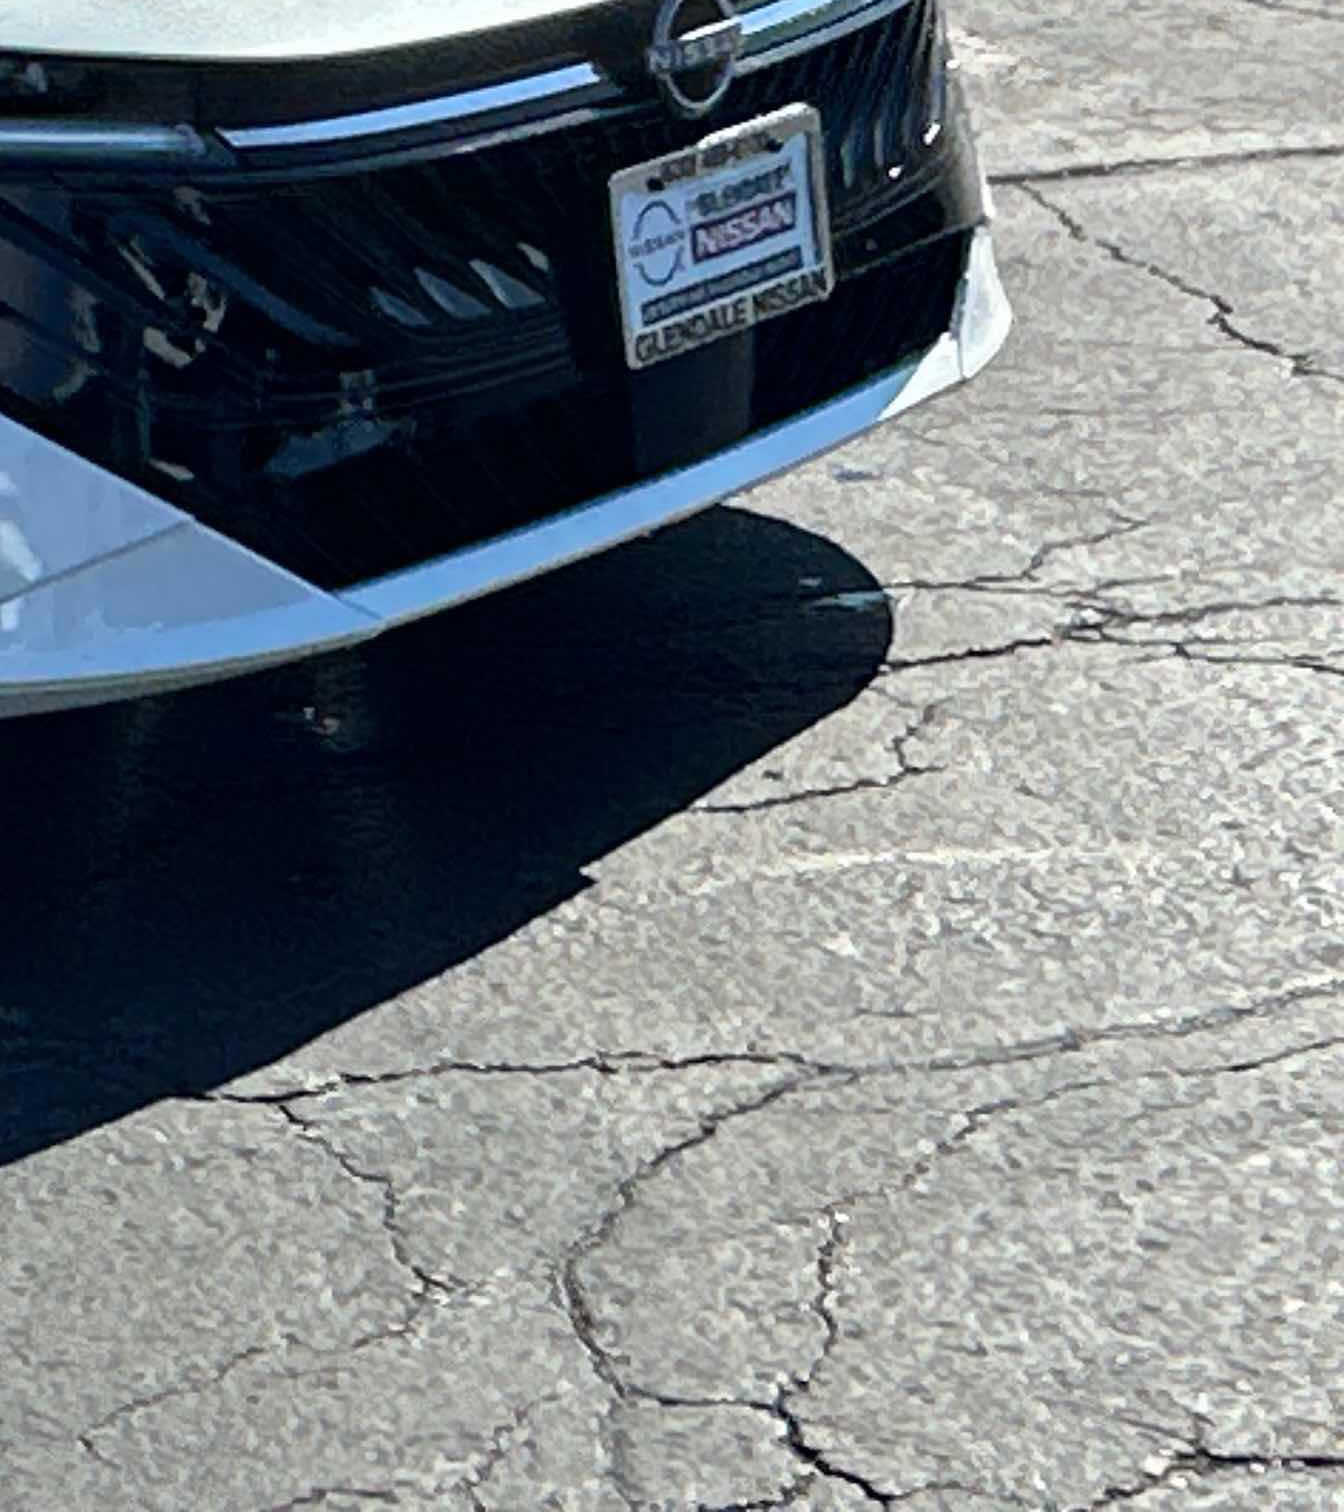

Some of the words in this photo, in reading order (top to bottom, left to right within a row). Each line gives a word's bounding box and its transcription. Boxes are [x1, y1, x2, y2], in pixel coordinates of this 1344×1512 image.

[649, 29, 739, 72] NIS
[635, 297, 747, 361] GLENDALE
[753, 268, 827, 314] NISSAN
